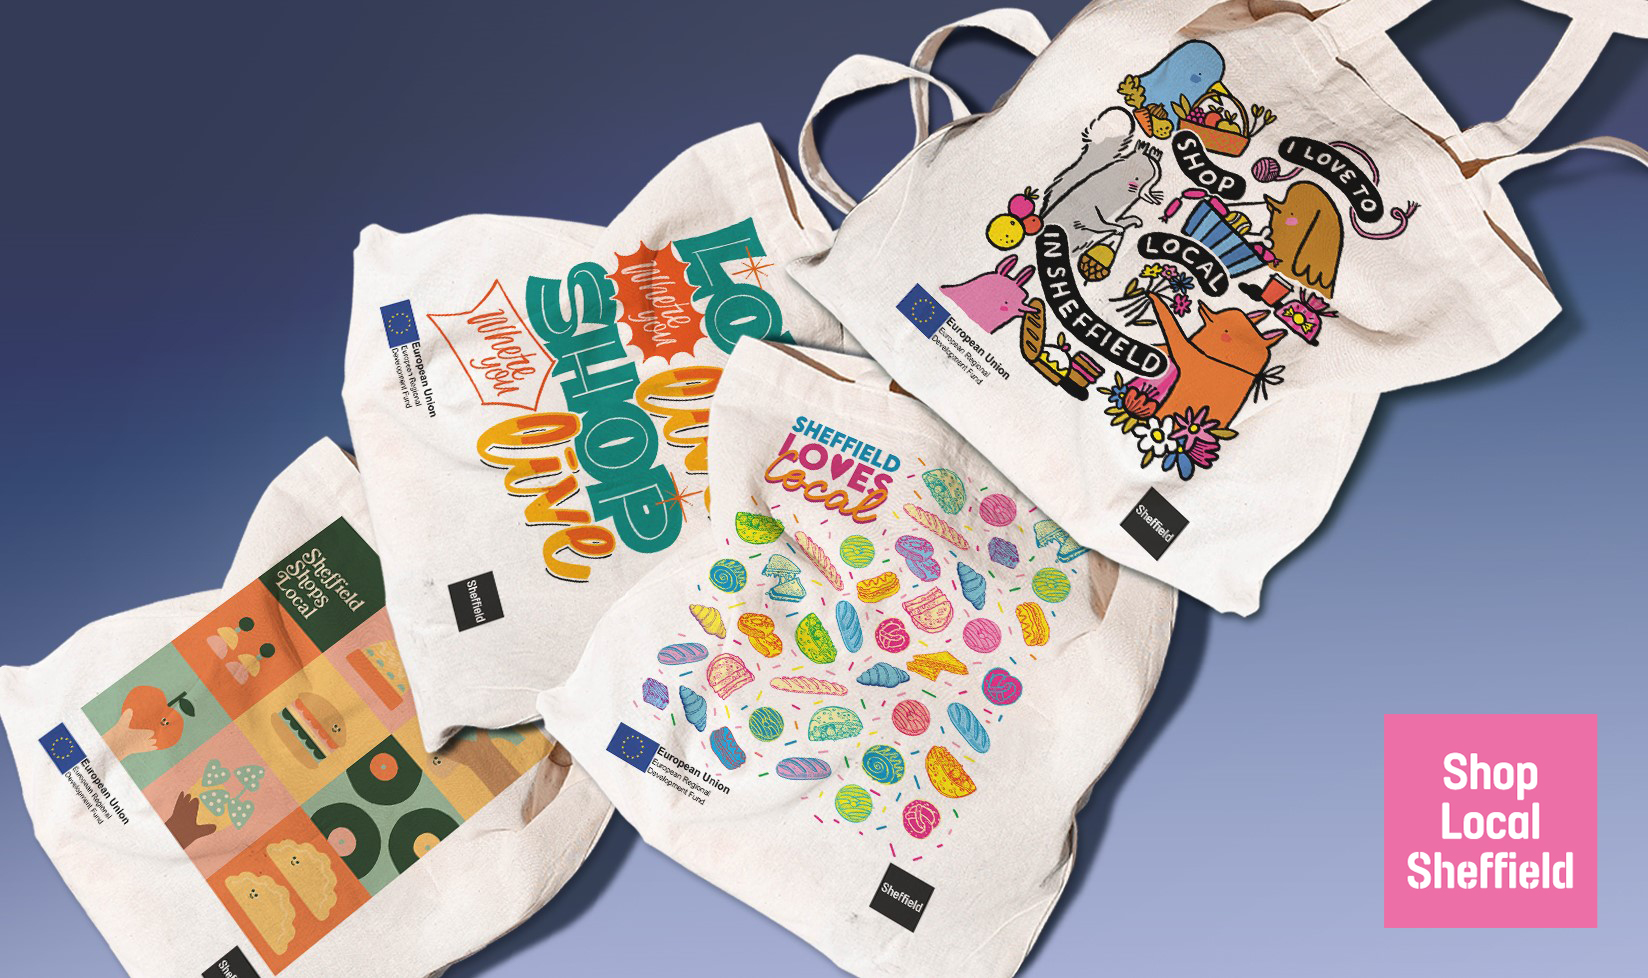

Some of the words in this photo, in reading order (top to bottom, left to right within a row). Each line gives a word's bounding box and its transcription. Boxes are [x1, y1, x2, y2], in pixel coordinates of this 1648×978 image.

[1177, 138, 1234, 192] SHOP
[1287, 141, 1296, 153] I
[1304, 148, 1357, 184] LOVE
[1352, 185, 1377, 212] TO
[1043, 232, 1062, 257] IN
[1147, 237, 1223, 292] LOCAL
[628, 310, 677, 347] you
[1046, 267, 1161, 373] SHEFFIELD
[931, 335, 967, 372] Development
[967, 368, 983, 385] Fund
[938, 327, 965, 354] European
[964, 352, 991, 378] Regional
[946, 316, 985, 357] European
[985, 353, 1010, 380] Union
[392, 348, 406, 390] Development
[402, 390, 412, 409] Fund
[401, 345, 413, 376] European
[409, 377, 422, 407] Regional
[412, 341, 428, 387] European
[424, 388, 436, 418] Union
[469, 356, 519, 396] you
[526, 262, 682, 553] SHOP
[792, 416, 900, 472] SHEFFIELD
[1135, 504, 1174, 543] Sheffield
[275, 570, 318, 620] Local
[286, 560, 329, 608] Shops
[302, 548, 365, 612] Sheffield
[467, 579, 486, 623] Sheffield
[73, 766, 93, 794] European
[92, 793, 112, 820] Regional
[81, 758, 111, 798] European
[110, 797, 129, 825] Union
[647, 767, 688, 796] Development
[688, 791, 706, 805] Fund
[651, 758, 682, 780] European
[682, 776, 711, 797] Regional
[657, 746, 701, 777] European
[702, 772, 730, 795] Union
[65, 772, 92, 810] Development
[90, 808, 103, 825] Fund
[881, 882, 923, 913] Sheffield
